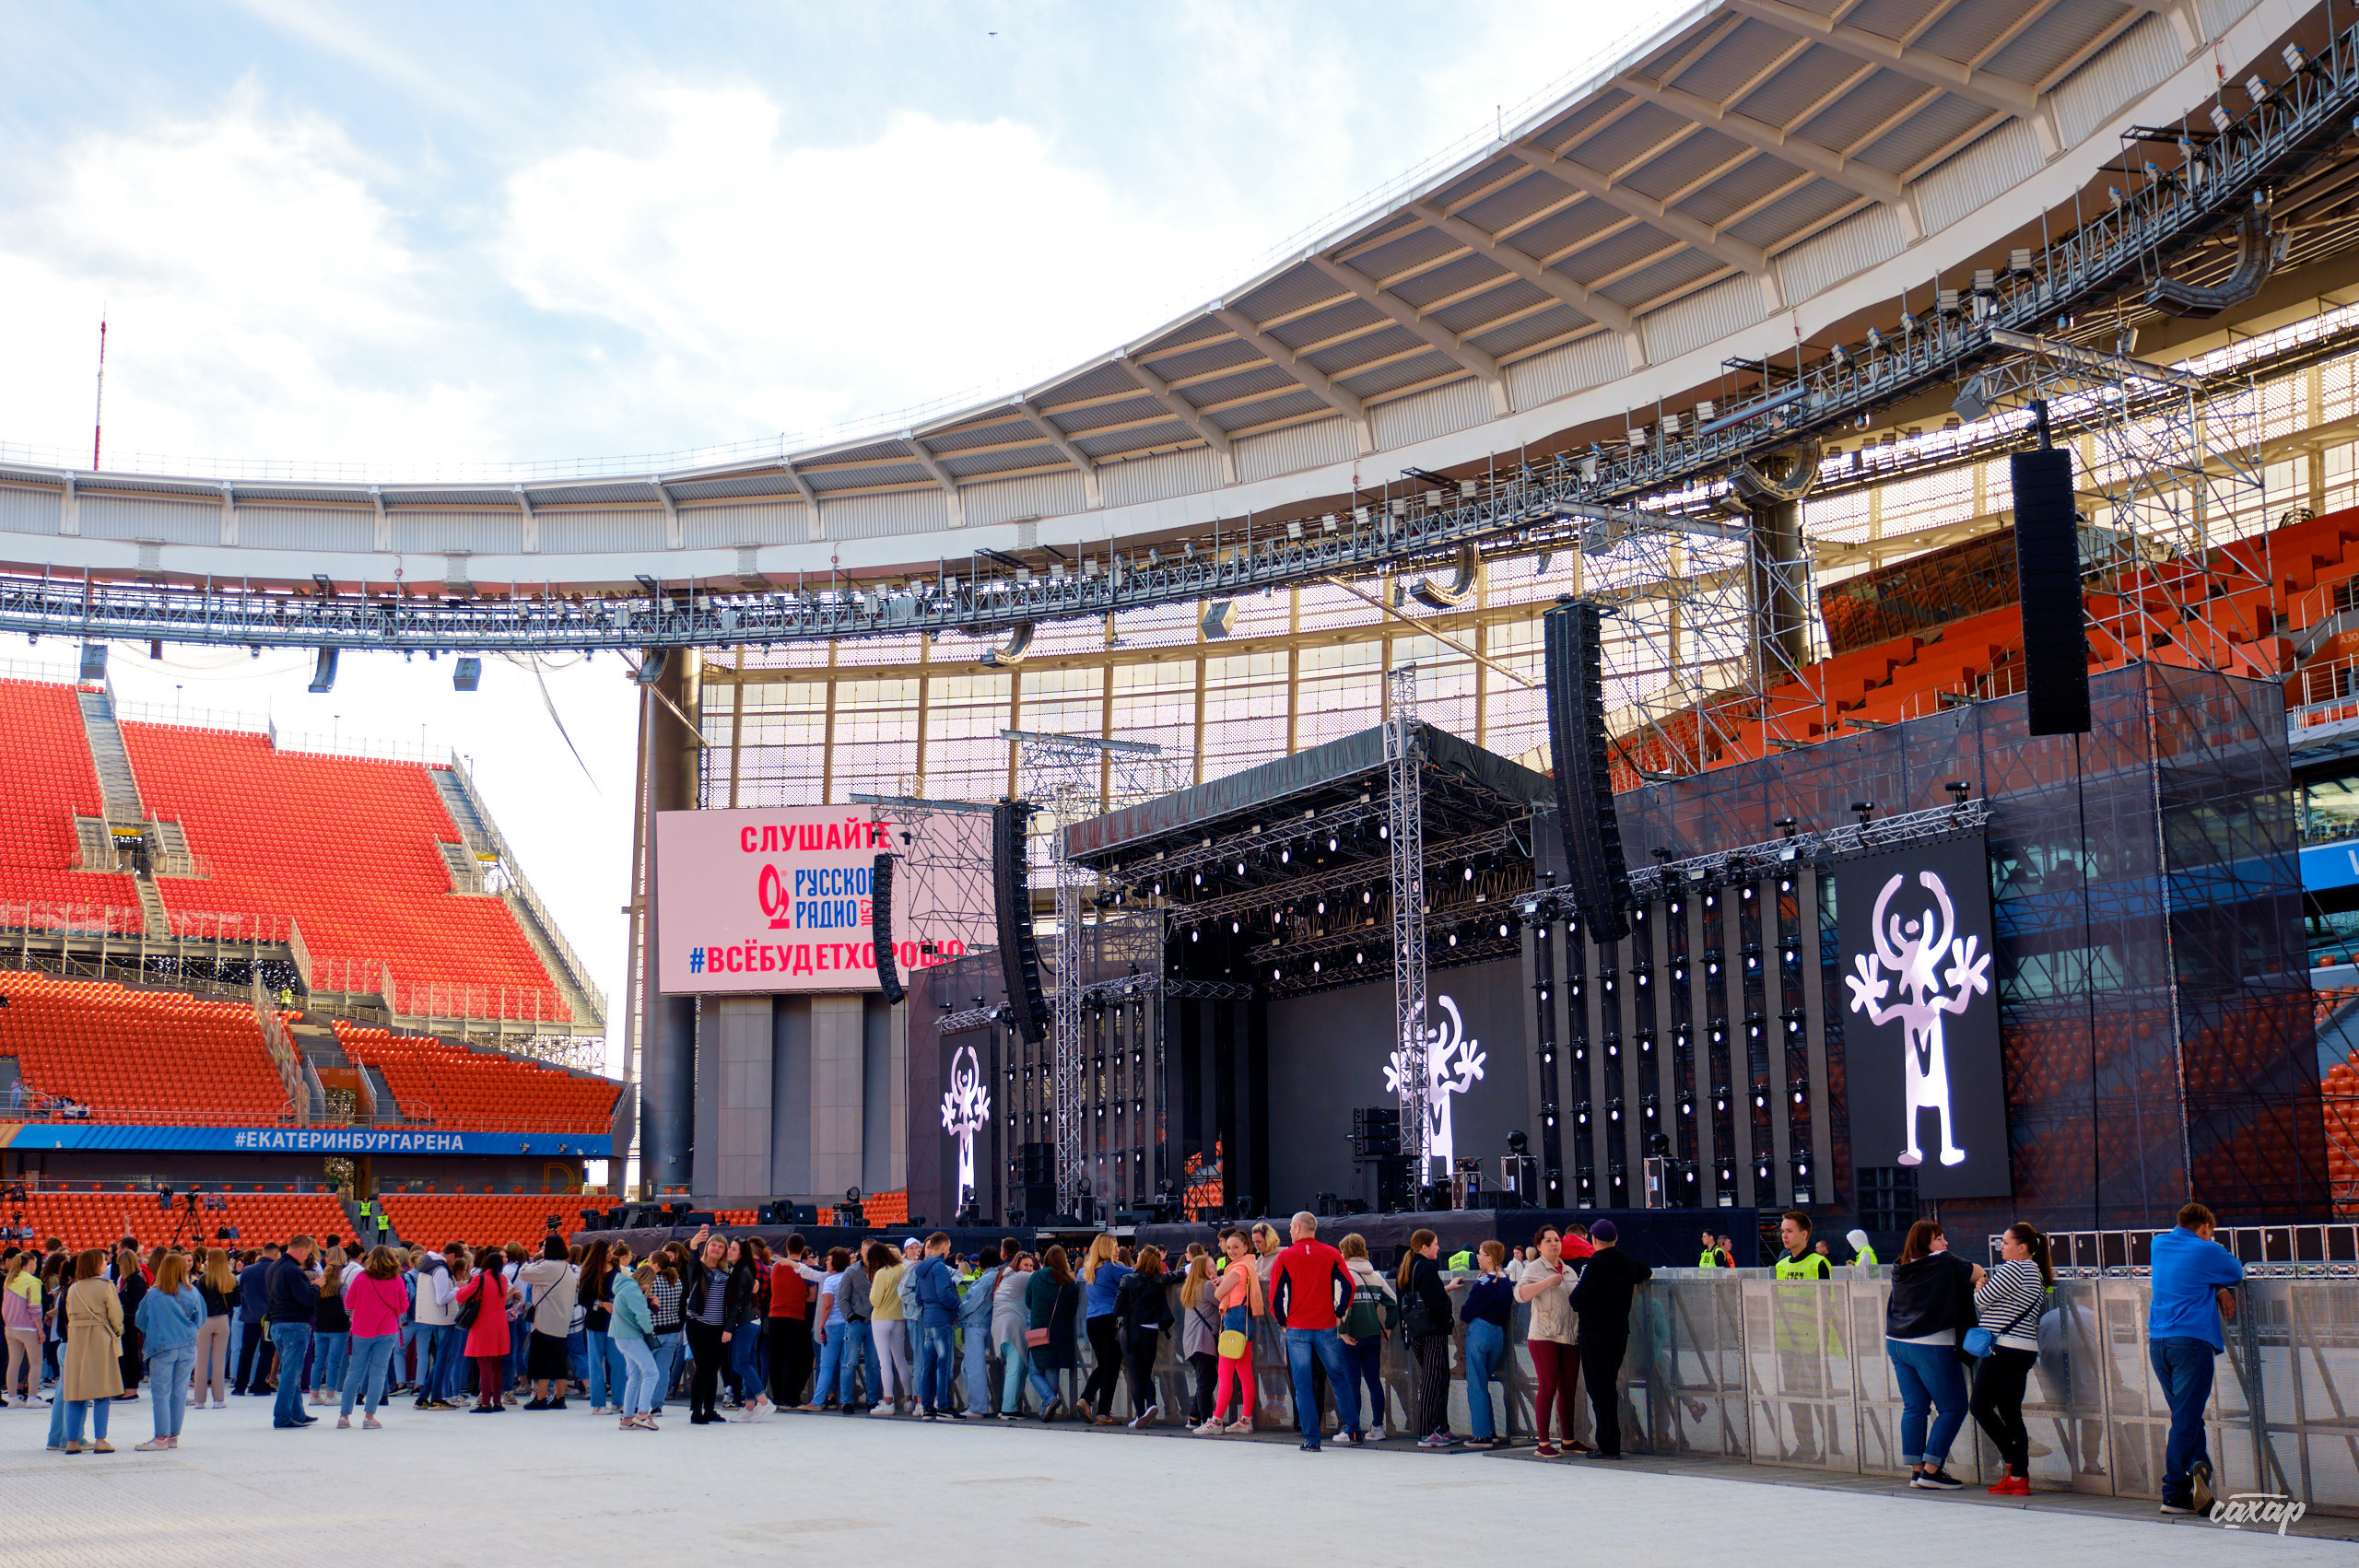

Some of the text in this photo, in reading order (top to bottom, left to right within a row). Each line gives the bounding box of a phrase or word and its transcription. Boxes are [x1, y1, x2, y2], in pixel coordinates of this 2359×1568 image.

[741, 817, 891, 853] СЛУШАЙТЕ
[796, 899, 857, 929] РАДИО
[235, 1131, 464, 1151] #ЕКАТЕРИНБУРГАРЕНА
